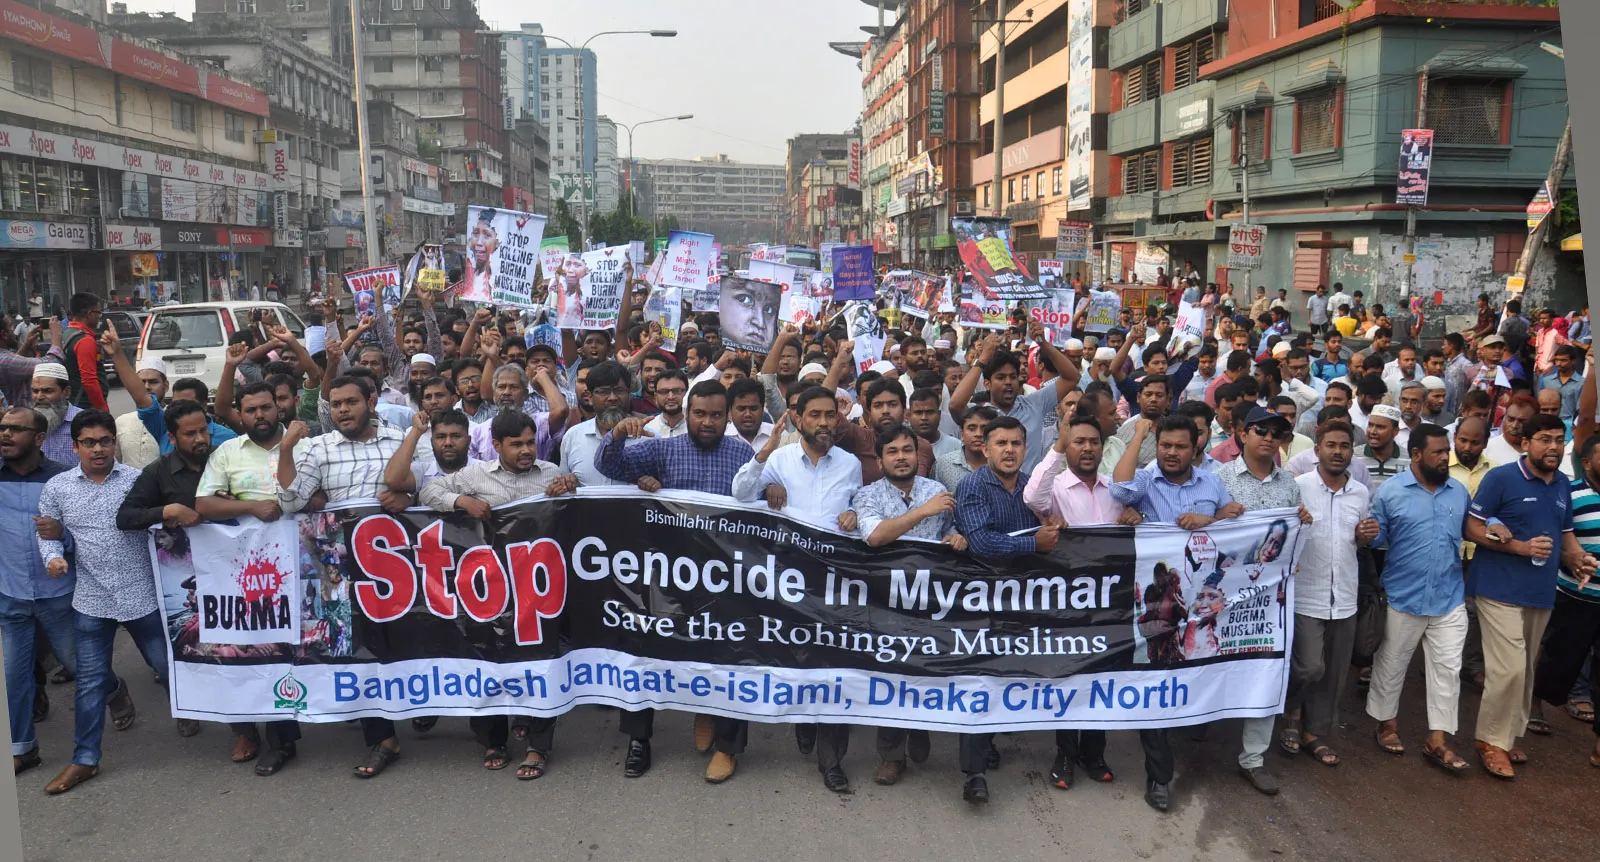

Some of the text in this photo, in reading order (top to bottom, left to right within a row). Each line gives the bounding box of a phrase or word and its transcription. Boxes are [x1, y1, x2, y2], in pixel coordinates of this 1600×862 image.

[30, 130, 56, 156] Apex
[72, 138, 96, 162] Apex
[123, 148, 142, 169] Apex
[155, 153, 172, 173] Apex
[272, 149, 289, 183] Apex
[184, 159, 200, 178] Apex
[209, 164, 225, 182] Apex
[233, 169, 247, 184] Apex
[254, 172, 267, 187] Apex
[10, 226, 34, 234] MEGA
[48, 223, 85, 239] Galanz
[133, 227, 153, 248] Apex
[179, 232, 202, 242] SONY
[106, 230, 124, 248] pex
[507, 232, 529, 249] STOP
[680, 239, 699, 247] Right
[500, 261, 527, 279] BURMA
[597, 260, 618, 271] STOP
[673, 265, 700, 275] Boycott
[675, 275, 695, 283] Israel
[837, 279, 872, 287] numbered
[592, 285, 617, 296] BURMA
[1031, 307, 1070, 328] Stop
[645, 509, 835, 553] Bismillahir Rahmanir Rahim
[1193, 536, 1208, 545] STOP
[245, 574, 276, 590] SAVE
[352, 513, 567, 645] Stop
[572, 536, 1120, 620] Genocide in Myanmar
[1239, 585, 1268, 599] STOP
[203, 595, 291, 631] BURMA
[1229, 609, 1265, 624] BURMA
[602, 600, 1107, 663] Save the Rohingya Muslims
[1221, 640, 1236, 648] SAVE
[335, 660, 1188, 717] Bangladesh Jamaat-e-islami, Dhaka City North
